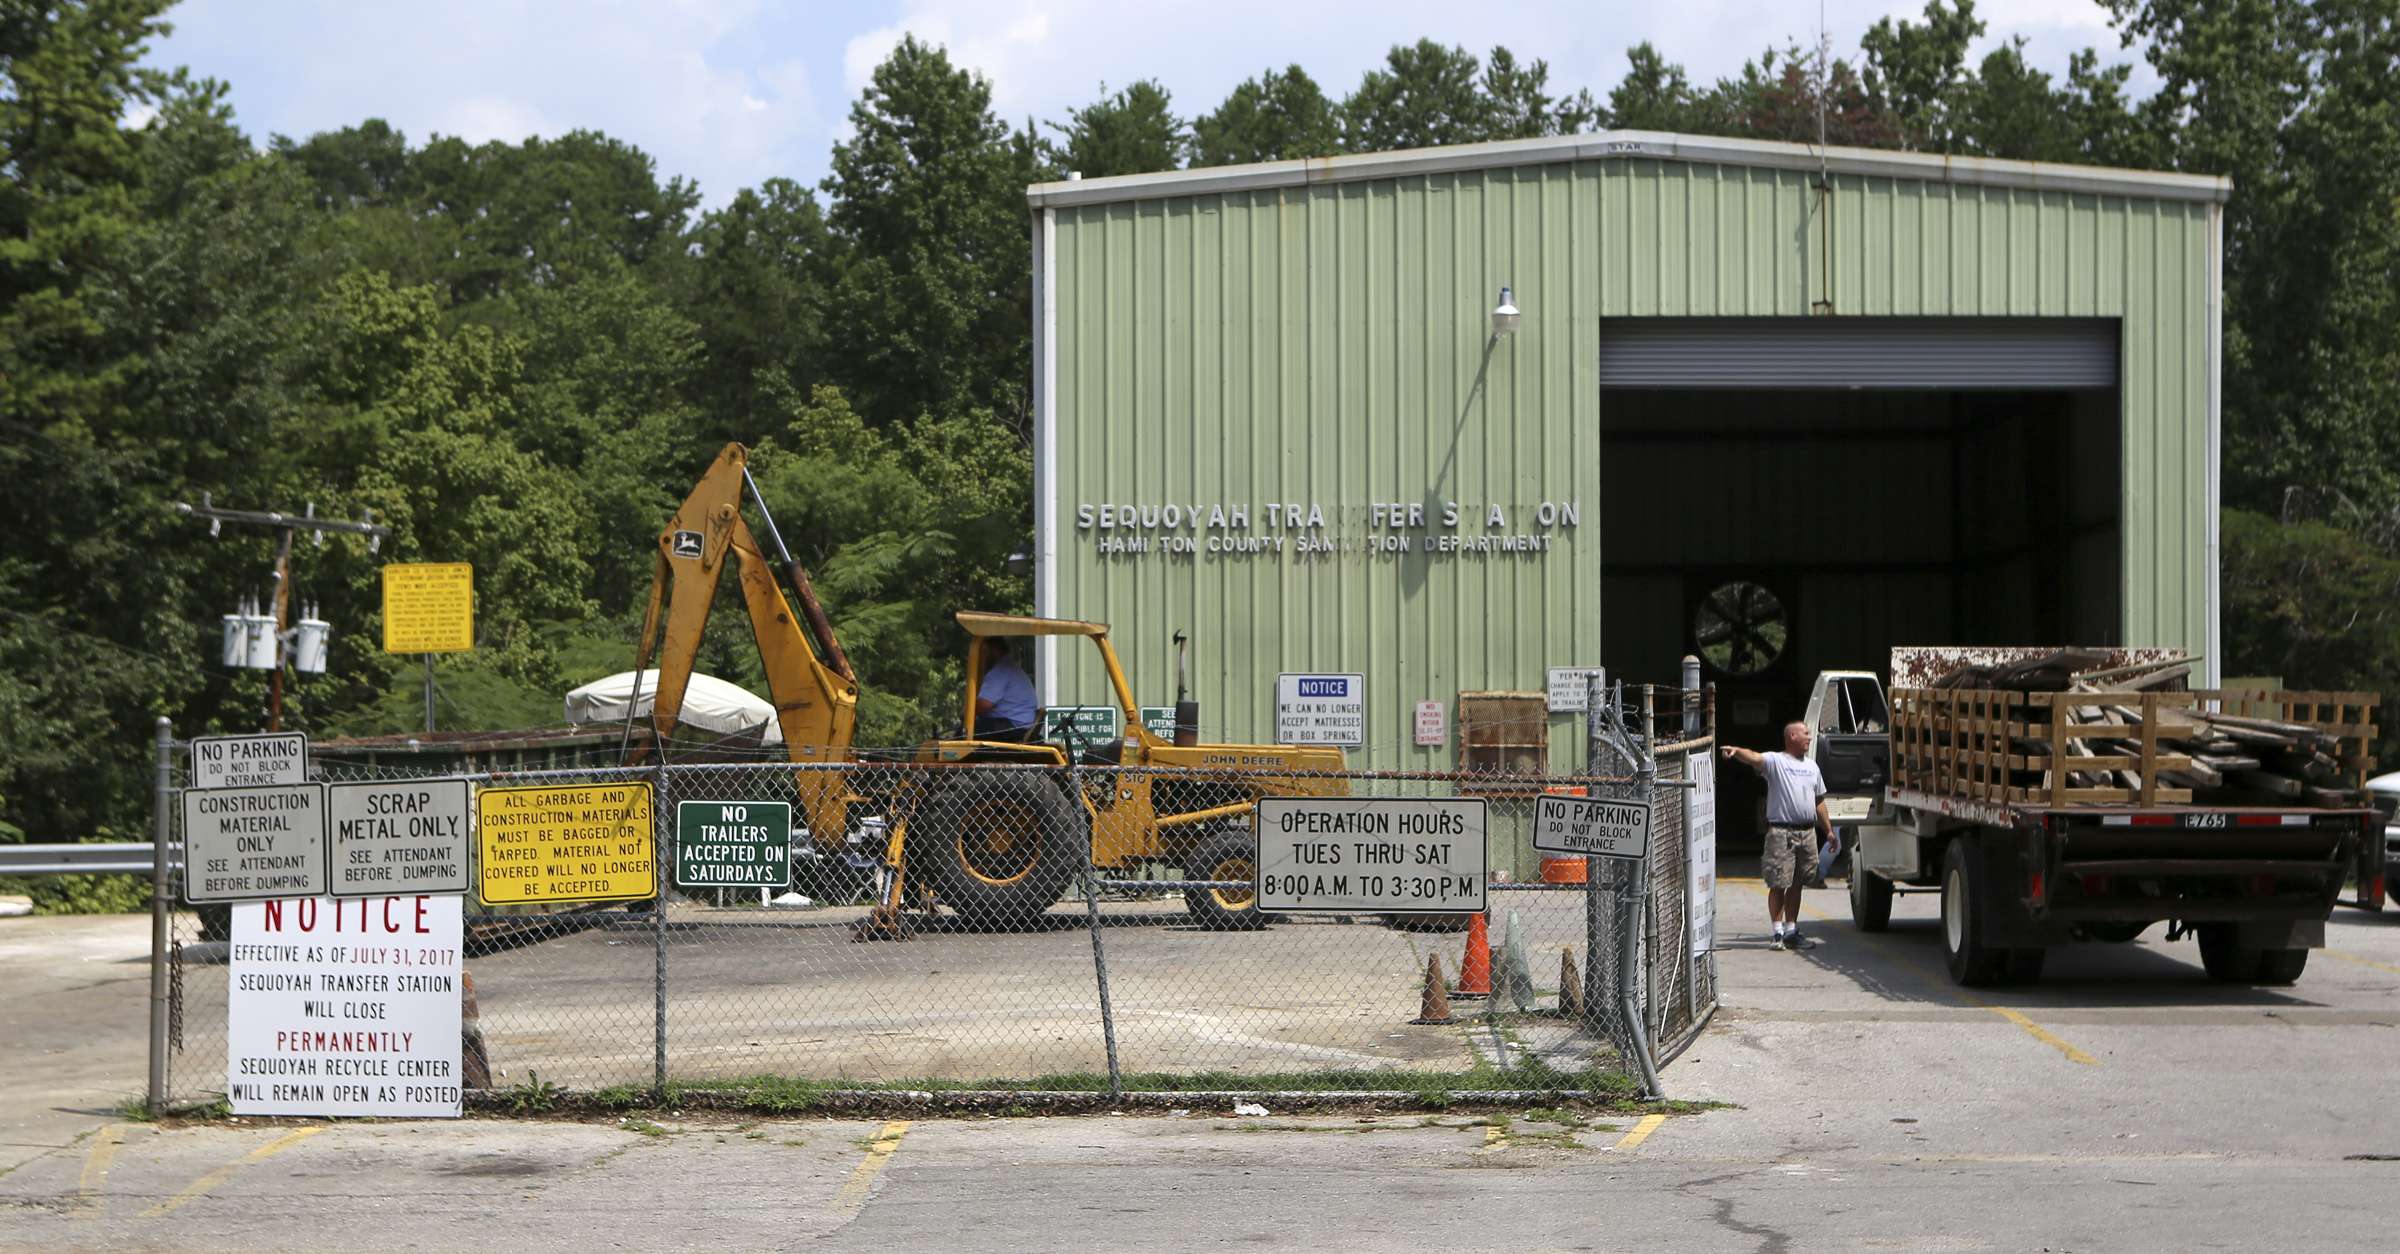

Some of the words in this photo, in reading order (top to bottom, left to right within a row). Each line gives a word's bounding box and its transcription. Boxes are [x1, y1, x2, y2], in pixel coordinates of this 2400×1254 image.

[1078, 504, 1248, 529] SEQUOYAH
[1266, 504, 1424, 528] TRAFER
[1100, 537, 1196, 553] HAMITON
[1209, 537, 1284, 552] COUNTY
[1425, 536, 1552, 551] DEPARTMENT
[1301, 682, 1344, 694] NOTICE
[1281, 704, 1291, 713] WE
[1297, 704, 1312, 713] CAN
[1316, 704, 1327, 713] NO
[1332, 704, 1361, 713] LONGER
[1148, 720, 1176, 728] ATTEND
[1281, 717, 1308, 727] ACCEPT
[1315, 717, 1361, 727] MATTRESSES
[1284, 731, 1293, 740] OR
[1301, 731, 1315, 740] BOX
[202, 745, 223, 761] NO
[231, 740, 297, 759] PARKING
[209, 762, 223, 774] DO
[231, 762, 251, 773] NOT
[259, 760, 291, 771] BLOCK
[1202, 755, 1237, 764] JOHN
[1242, 756, 1283, 766] DEERE
[225, 774, 276, 786] ENTRANCE
[200, 794, 309, 813] CONSTRUCTION
[367, 793, 430, 815] SCRAP
[505, 796, 527, 807] ALL
[536, 793, 591, 806] GARBAGE
[602, 792, 625, 803] AND
[484, 812, 573, 826] CONSTRUCTION
[582, 808, 647, 822] MATERIALS
[722, 807, 747, 822] NO
[1544, 802, 1565, 819] NO
[1574, 805, 1642, 826] PARKING
[220, 816, 291, 834] MATERIAL
[339, 819, 400, 840] METAL
[409, 816, 458, 838] ONLY
[1281, 812, 1388, 833] OPERATION
[1399, 814, 1463, 834] HOURS
[1550, 822, 1563, 833] DO
[1572, 824, 1591, 836] NOT
[1600, 827, 1632, 839] BLOCK
[498, 831, 529, 843] MUST
[539, 830, 553, 841] BE
[563, 828, 610, 840] BAGGED
[619, 826, 635, 837] OR
[701, 826, 768, 842] TRAILERS
[1564, 835, 1615, 850] ENTRANCE
[237, 836, 274, 852] ONLY
[492, 849, 540, 861] TARPED.
[553, 846, 610, 858] MATERIAL
[619, 844, 641, 856] NOT
[350, 851, 372, 863] SEE
[384, 847, 451, 863] ATTENDANT
[685, 845, 755, 862] ACCEPTED
[765, 846, 783, 862] ON
[1292, 844, 1340, 864] TUES
[1354, 844, 1404, 864] THRU
[1415, 844, 1451, 864] SAT
[207, 860, 228, 872] SEE
[240, 856, 305, 870] ATTENDANT
[485, 866, 539, 879] COVERED
[547, 865, 573, 876] WILL
[581, 863, 597, 874] NO
[604, 861, 650, 873] LONGER
[345, 866, 392, 882] BEFORE
[403, 864, 456, 879] DUMPING
[689, 865, 777, 881] SATURDAYS.
[206, 878, 251, 891] BEFORE
[256, 876, 308, 890] DUMPING
[525, 884, 539, 895] BE
[549, 880, 612, 894] ACCEPTED.
[1265, 875, 1308, 896] 8:00
[1314, 875, 1352, 895] A.M.
[1360, 876, 1383, 896] TO
[1391, 877, 1435, 898] 3:30
[1440, 877, 1478, 897] P.M.
[265, 896, 430, 933] NOTICE
[235, 945, 298, 962] EFFECTIVE
[307, 947, 323, 962] AS
[331, 948, 346, 963] OF
[350, 948, 386, 965] JULY
[393, 949, 412, 966] 31,
[419, 950, 454, 966] 2017
[240, 974, 311, 991] SEQUOYAH
[321, 975, 389, 992] TRANSFER
[398, 976, 451, 993] STATION
[305, 1001, 335, 1018] WILL
[345, 1002, 385, 1019] CLOSE
[278, 1031, 412, 1052] PERMANENTLY
[240, 1059, 315, 1075] SEQUOYAH
[326, 1060, 388, 1076] RECYCLE
[398, 1061, 449, 1077] CENTER
[233, 1084, 262, 1101] WILL
[273, 1084, 324, 1102] REMAIN
[333, 1085, 368, 1102] OPEN
[379, 1086, 396, 1102] AS
[406, 1086, 457, 1103] POSTED
